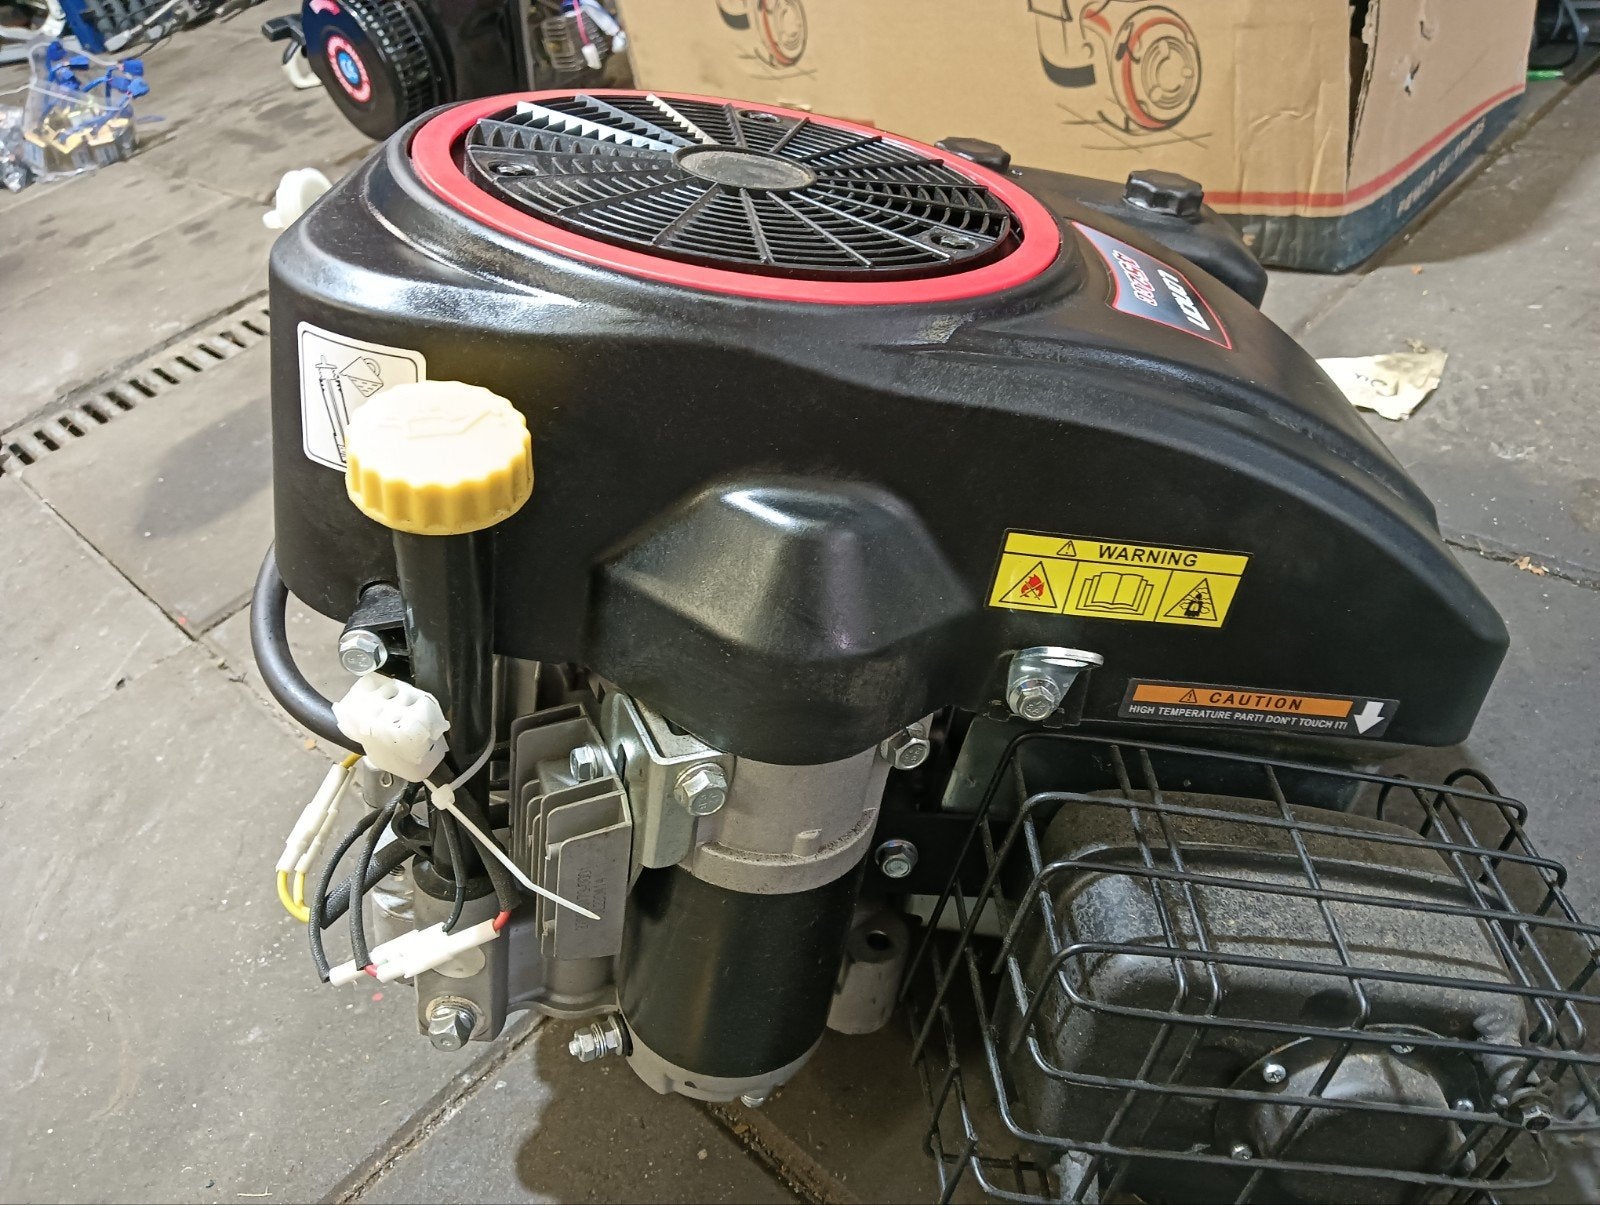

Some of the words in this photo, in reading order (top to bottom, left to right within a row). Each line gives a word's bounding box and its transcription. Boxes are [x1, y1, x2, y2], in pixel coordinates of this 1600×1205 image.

[1098, 544, 1199, 568] WARNING
[1209, 692, 1303, 711] CAUTION
[1128, 704, 1156, 715] HIGH
[1158, 706, 1233, 720] TEMPERATURE
[1233, 712, 1264, 723] PART!
[1265, 714, 1299, 726] DON'T
[1299, 717, 1332, 729] TOUCH
[1333, 721, 1348, 730] IT!
